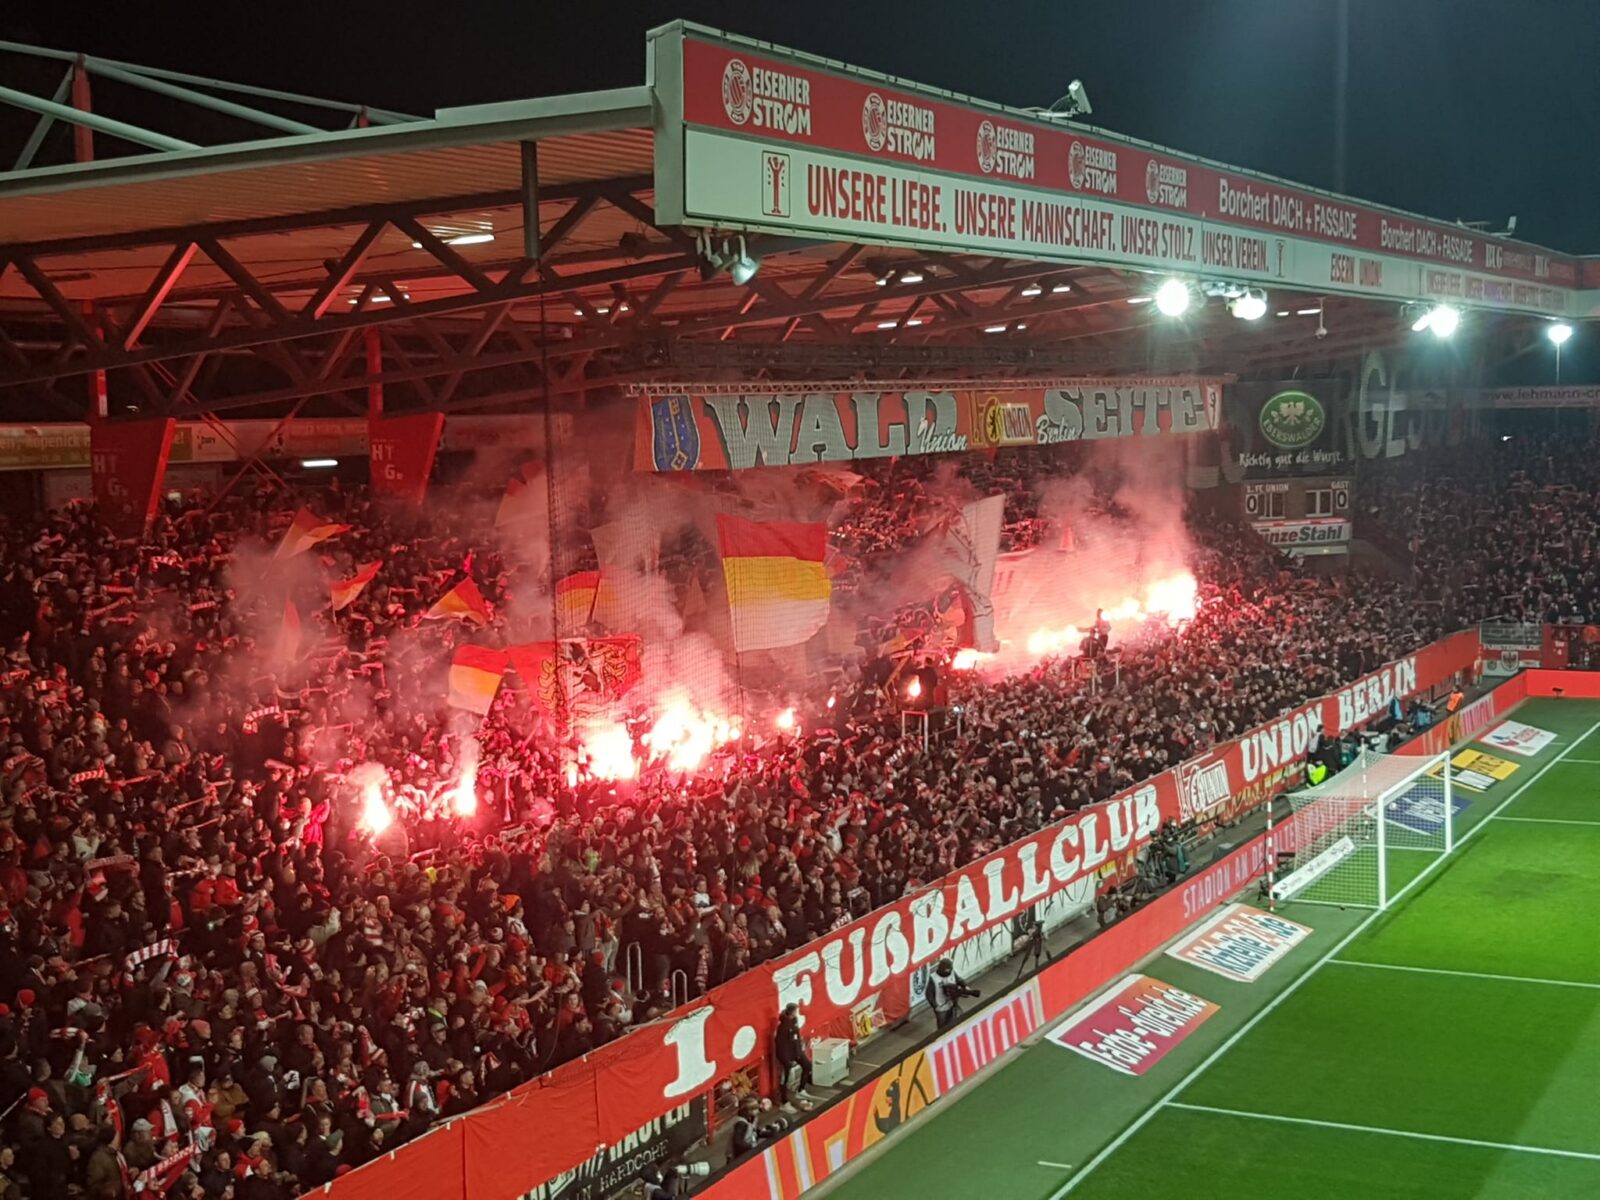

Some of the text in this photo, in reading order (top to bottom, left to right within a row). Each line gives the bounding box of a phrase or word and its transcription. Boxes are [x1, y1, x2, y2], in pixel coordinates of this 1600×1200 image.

[753, 67, 810, 105] EISERNER
[753, 98, 811, 135] STROM
[887, 100, 935, 134] EISERNER
[887, 128, 935, 160] STROM
[997, 127, 1034, 154] EISERNER
[996, 153, 1034, 179] STROM
[1084, 146, 1117, 171] EISERNER
[1084, 170, 1117, 193] STROM
[808, 164, 1269, 272] UNSERE LIEBE. UNSERE MANNSCHAFT. UNSER STOLZ. UNSER VEREIN.
[1219, 178, 1269, 222] Borchert
[1273, 195, 1302, 230] DACH
[1315, 204, 1357, 240] FASSADE
[1381, 219, 1414, 252] Borchert
[1417, 229, 1437, 254] DACH
[1443, 234, 1473, 263] FASSADE
[705, 385, 1204, 469] WALD SEITE
[919, 414, 1080, 453] Union Berlin
[1263, 417, 1321, 443] EBERSWALDER
[1240, 453, 1272, 469] Richtig
[1275, 454, 1292, 468] gut
[1295, 451, 1310, 464] die
[1265, 483, 1289, 492] UNION
[1331, 481, 1349, 489] GAST
[1337, 491, 1347, 508] 0
[1247, 495, 1257, 512] 0
[664, 1005, 757, 1098] 1.
[1241, 703, 1322, 781] UNION
[1338, 656, 1416, 732] BERLIN
[1183, 864, 1232, 918] STADION
[1235, 853, 1249, 886] AN
[1080, 986, 1208, 1069] Farbe-direkt.de
[600, 1139, 669, 1192] HARDCORE
